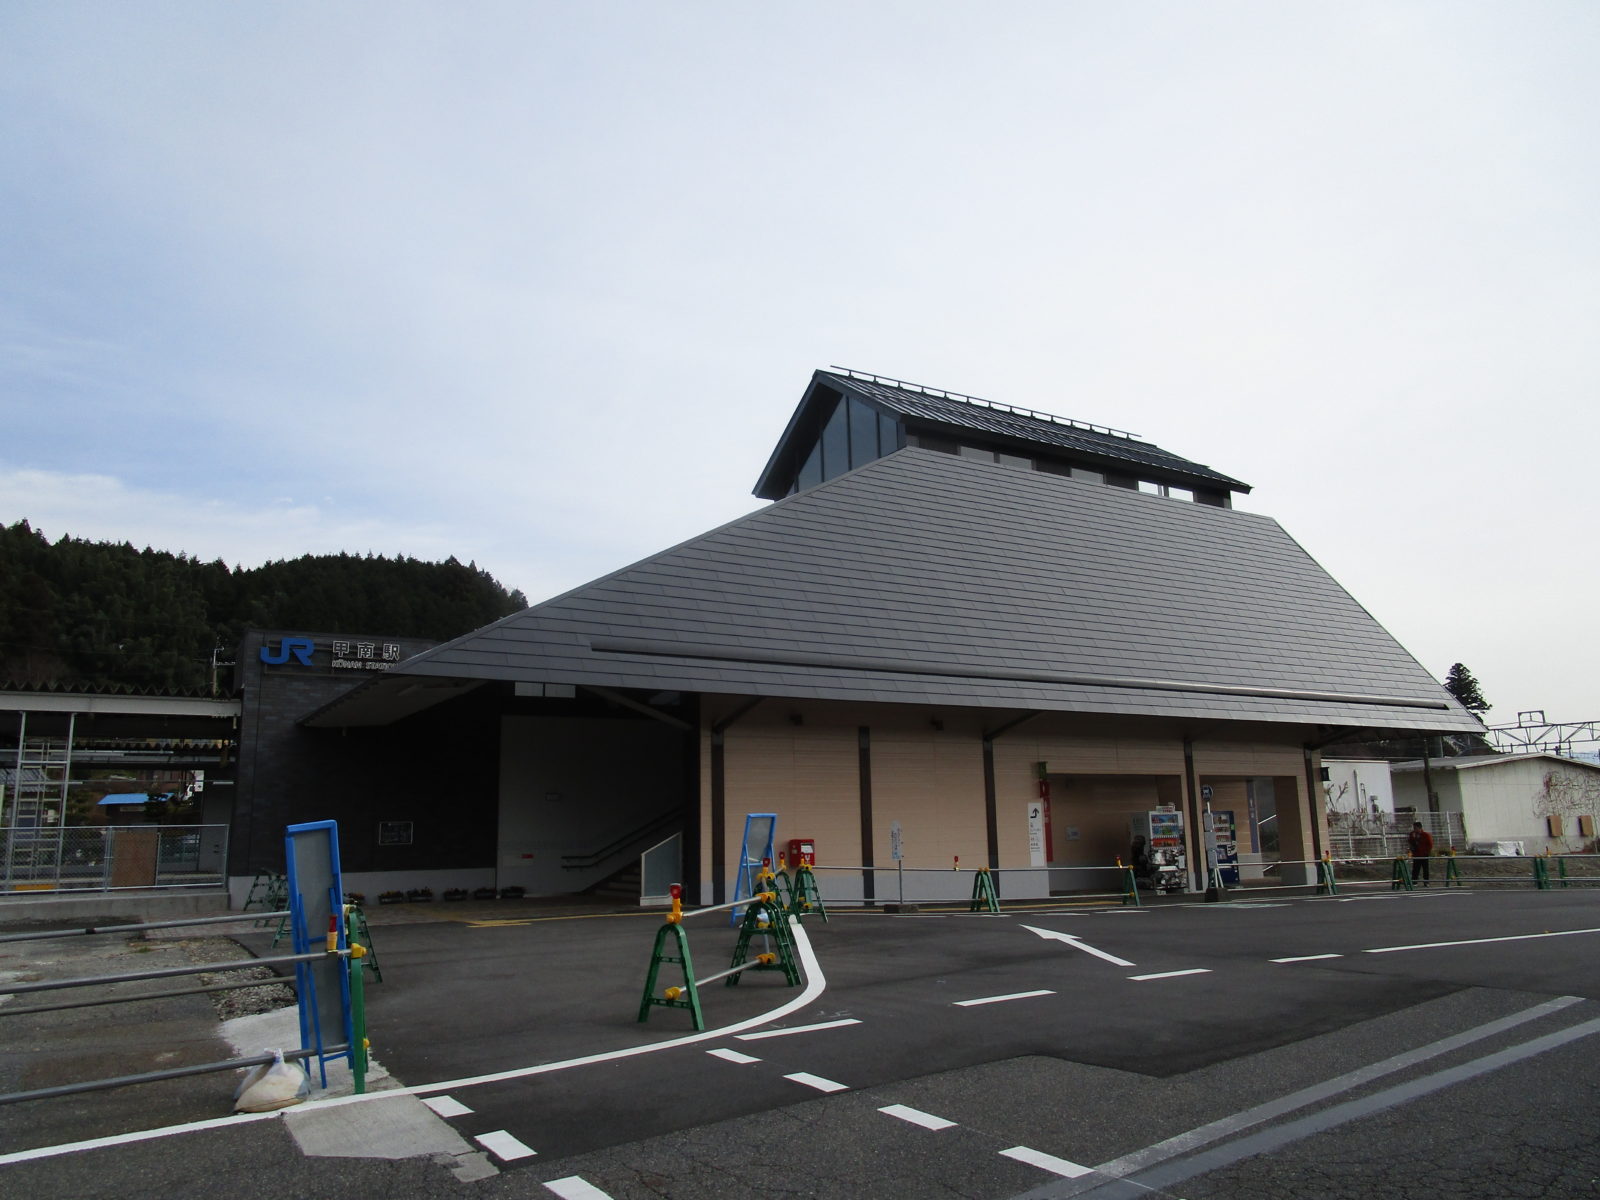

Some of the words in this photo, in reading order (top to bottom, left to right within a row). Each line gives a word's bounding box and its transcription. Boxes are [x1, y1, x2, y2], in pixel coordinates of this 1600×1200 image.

[260, 637, 313, 666] JR
[332, 640, 400, 661] 甲南駅
